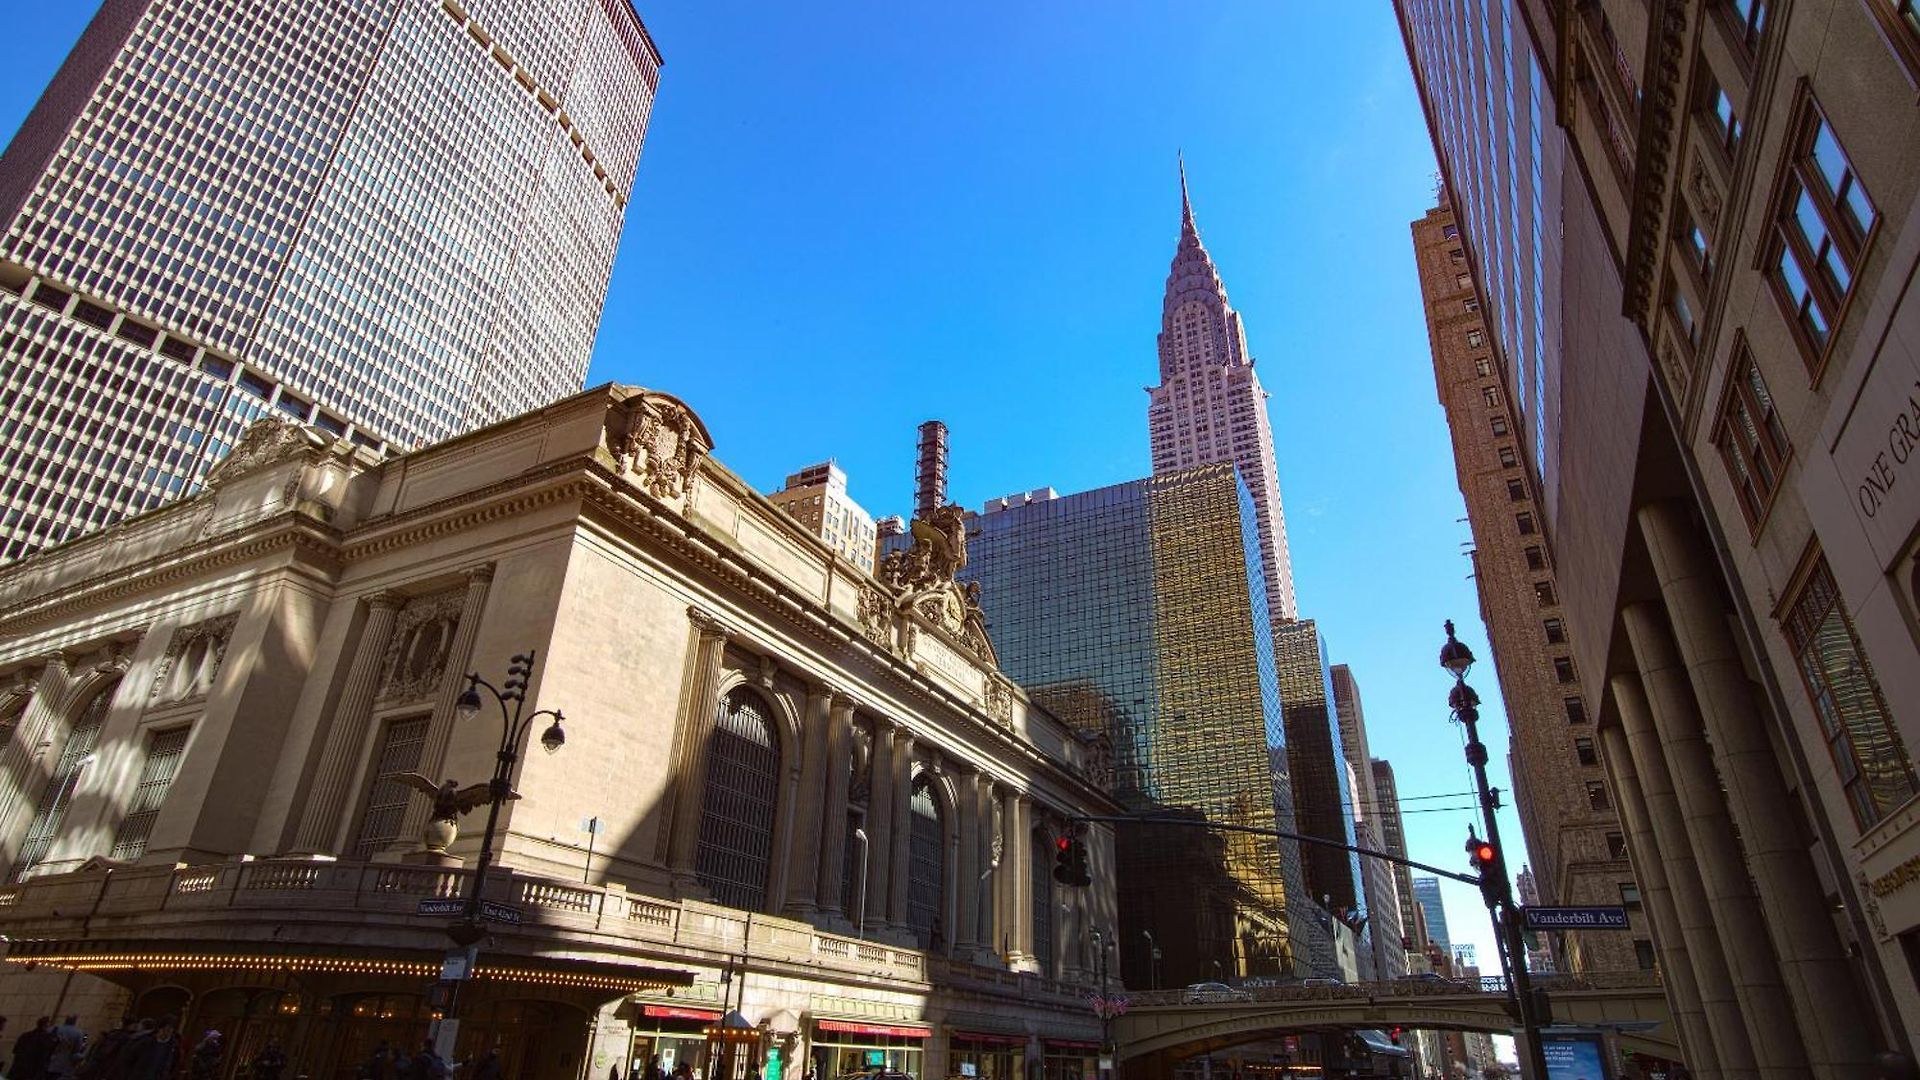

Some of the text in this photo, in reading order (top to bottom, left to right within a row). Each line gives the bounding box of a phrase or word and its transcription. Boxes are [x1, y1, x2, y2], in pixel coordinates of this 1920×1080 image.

[1858, 380, 1920, 519] ONE GRA
[1530, 912, 1623, 924] Vanderbilt Ave
[1243, 977, 1277, 987] HYATT
